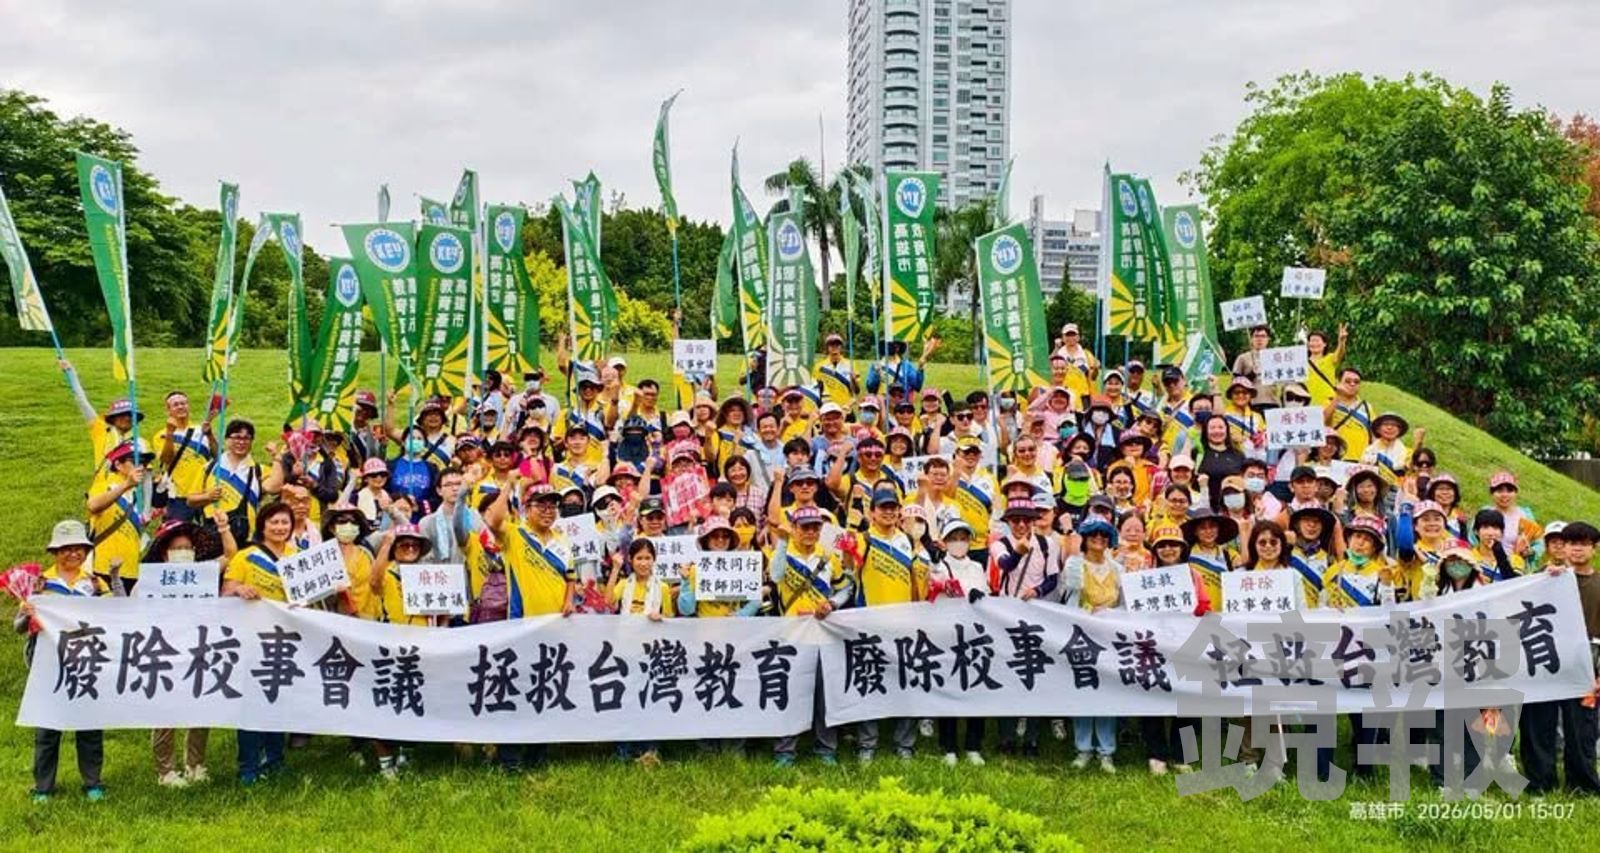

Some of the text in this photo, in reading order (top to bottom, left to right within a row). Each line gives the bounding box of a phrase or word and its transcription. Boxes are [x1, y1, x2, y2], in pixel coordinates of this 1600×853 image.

[1281, 409, 1308, 425] 廢除
[1270, 428, 1324, 443] 校事會議
[698, 557, 761, 573] 勞教同行
[160, 570, 198, 586] 拯救
[290, 569, 345, 601] 教師同心
[418, 570, 449, 586] 廢除
[699, 576, 760, 593] 教師同心
[1141, 573, 1175, 589] 拯救
[1240, 576, 1273, 592] 廢除
[407, 592, 466, 609] 校事會議
[1227, 598, 1292, 613] 校事會議
[843, 600, 1561, 697] 廢除校事會議 拯救台灣教育
[52, 620, 798, 718] 廢除校事會議 拯救台灣教育
